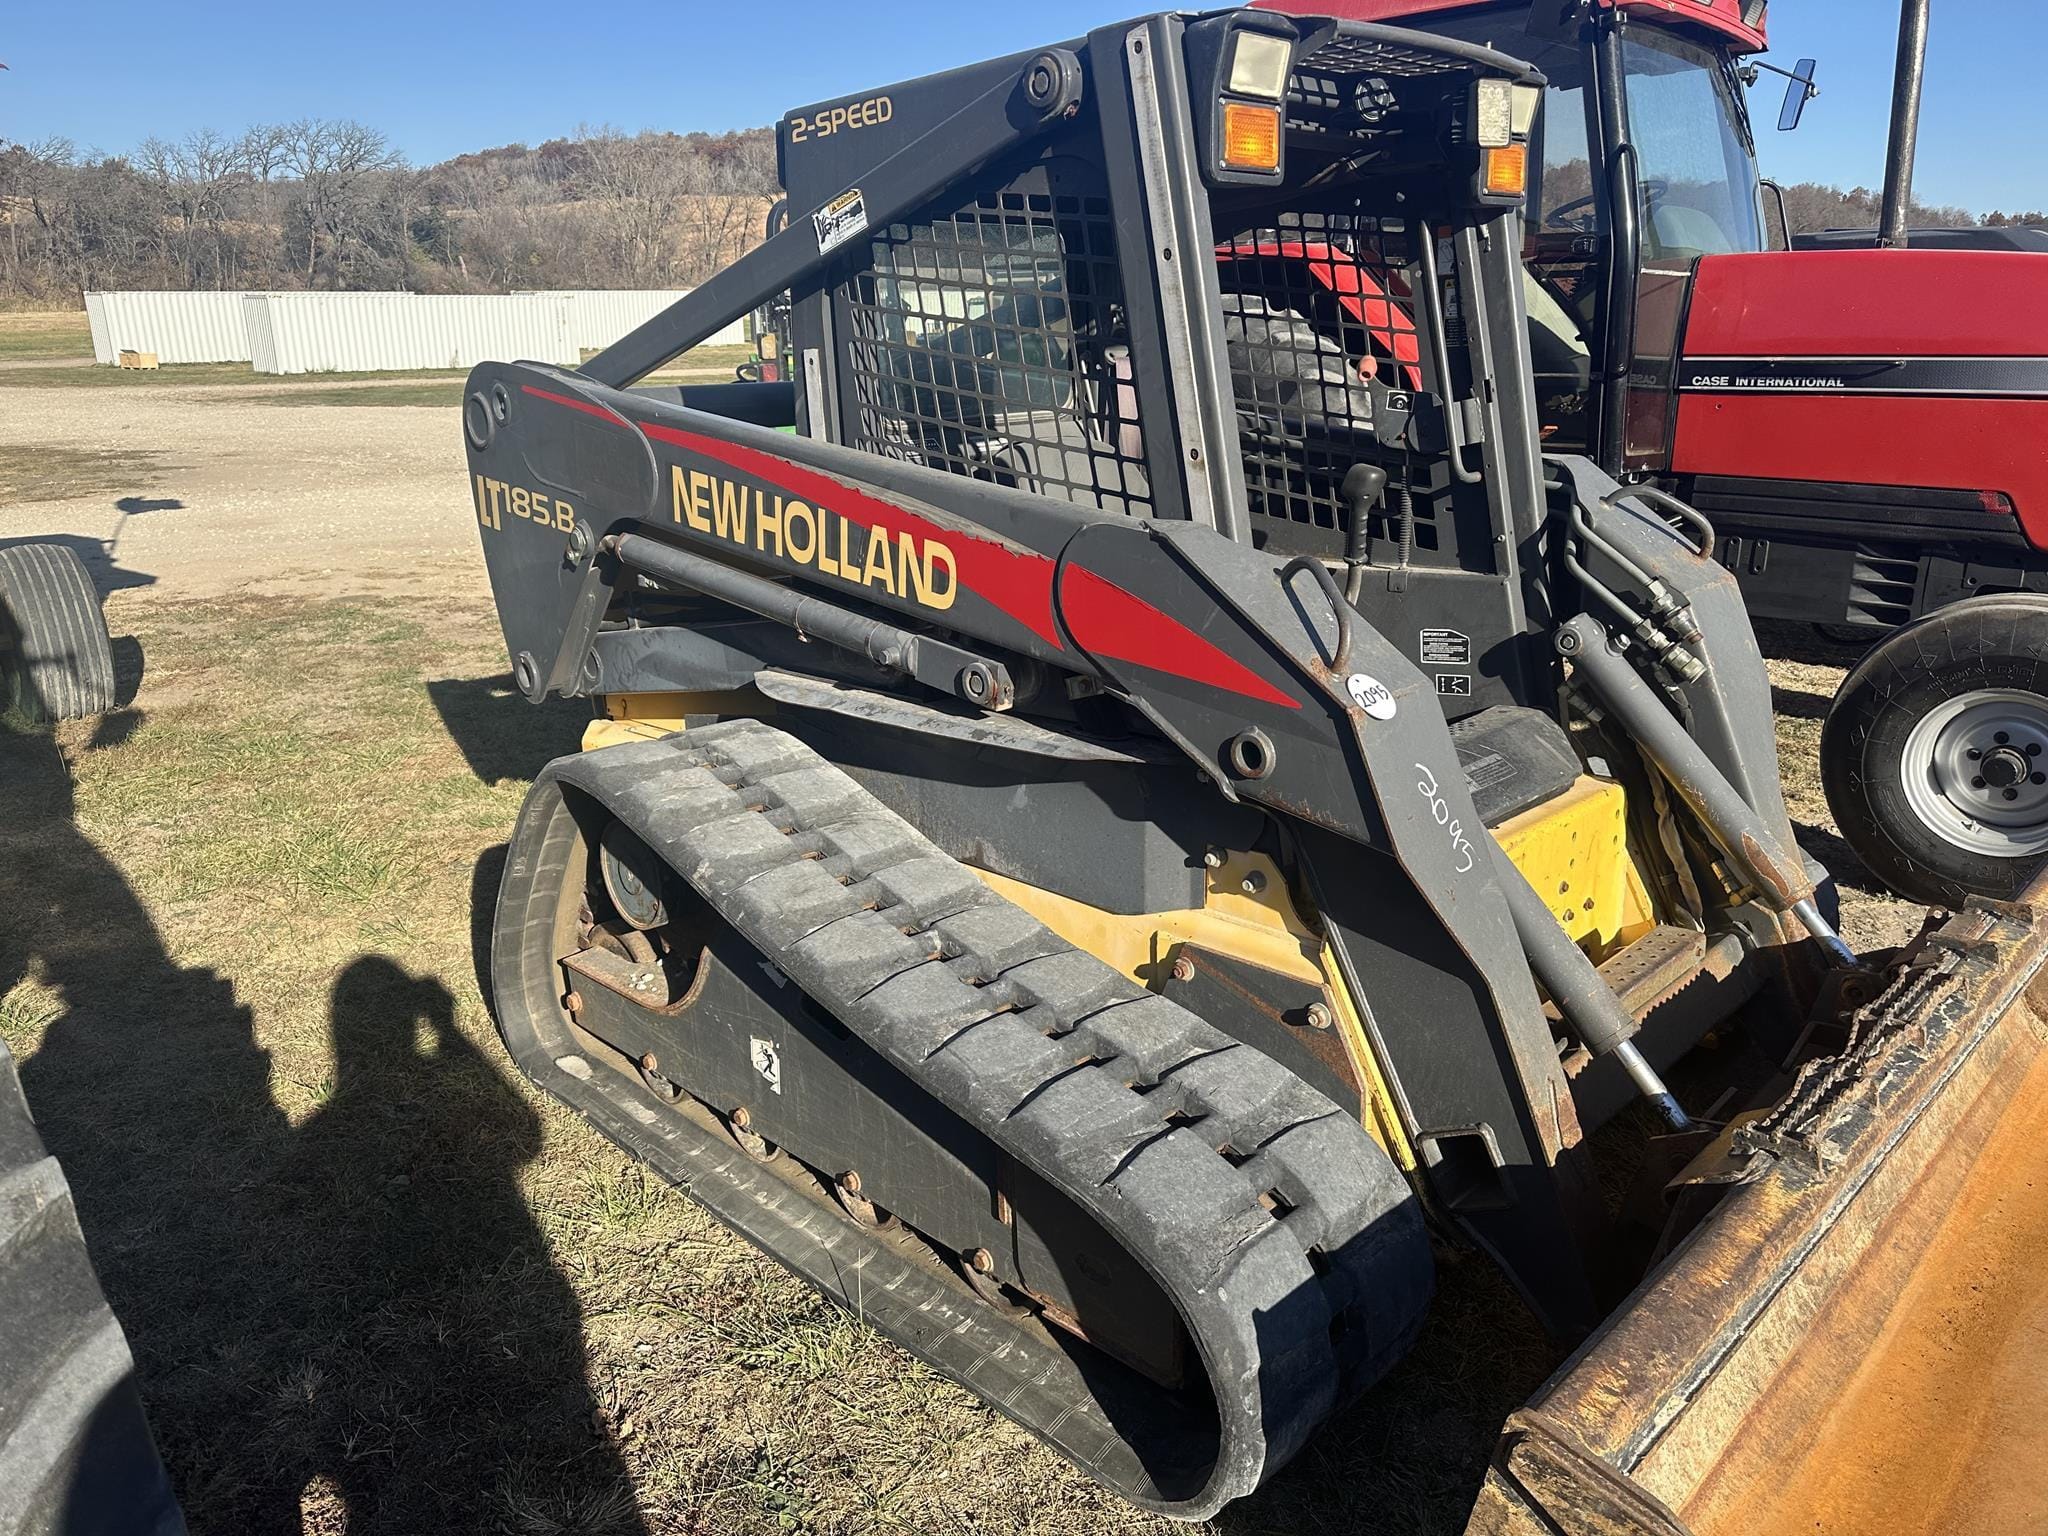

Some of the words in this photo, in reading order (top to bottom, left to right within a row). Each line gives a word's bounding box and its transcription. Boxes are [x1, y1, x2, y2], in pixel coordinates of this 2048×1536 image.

[791, 97, 893, 143] 2-SPEED
[1692, 376, 1729, 386] CASE
[1735, 376, 1845, 387] INTERNATIONAL
[671, 464, 749, 544] NEW
[755, 490, 958, 611] HOLLAND
[1354, 683, 1390, 708] 2095
[1415, 763, 1473, 873] 2095
